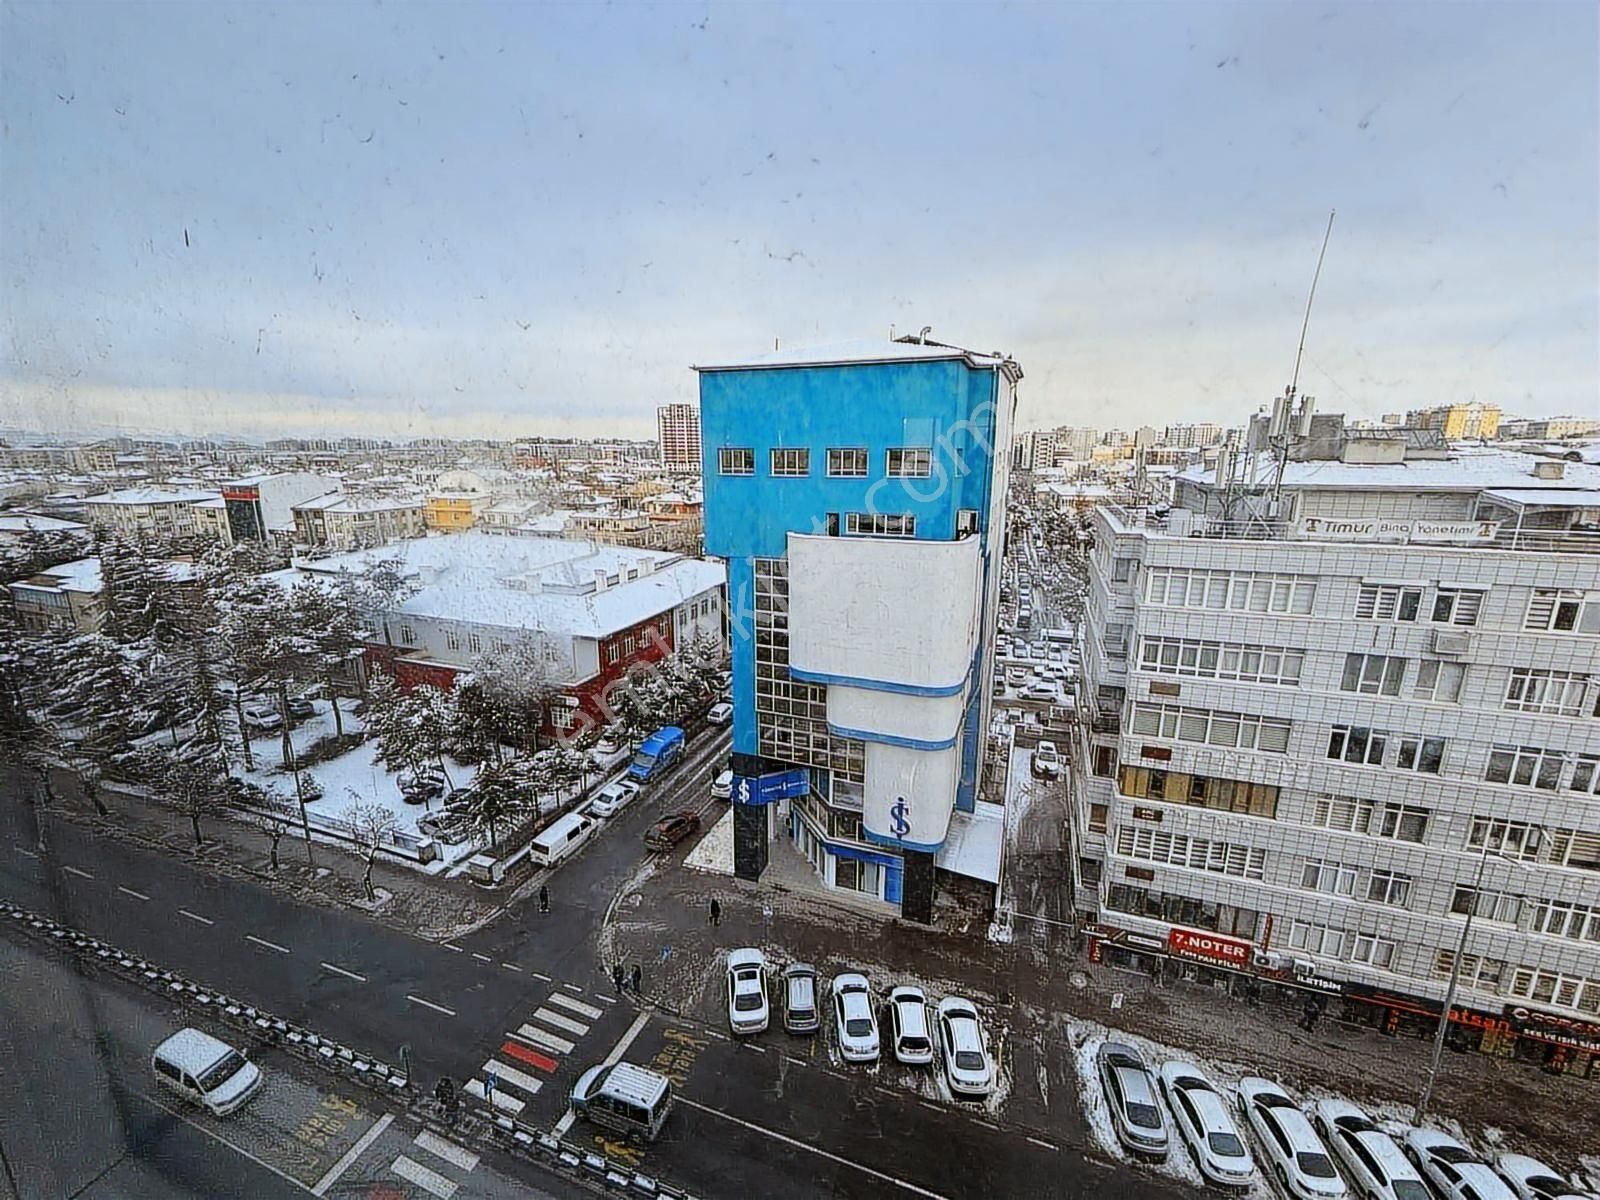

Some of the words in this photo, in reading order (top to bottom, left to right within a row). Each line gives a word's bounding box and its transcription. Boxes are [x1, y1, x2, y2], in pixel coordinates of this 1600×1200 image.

[1325, 521, 1374, 534] Timur
[1380, 523, 1409, 533] Bina
[1175, 933, 1246, 958] 7.NOTER
